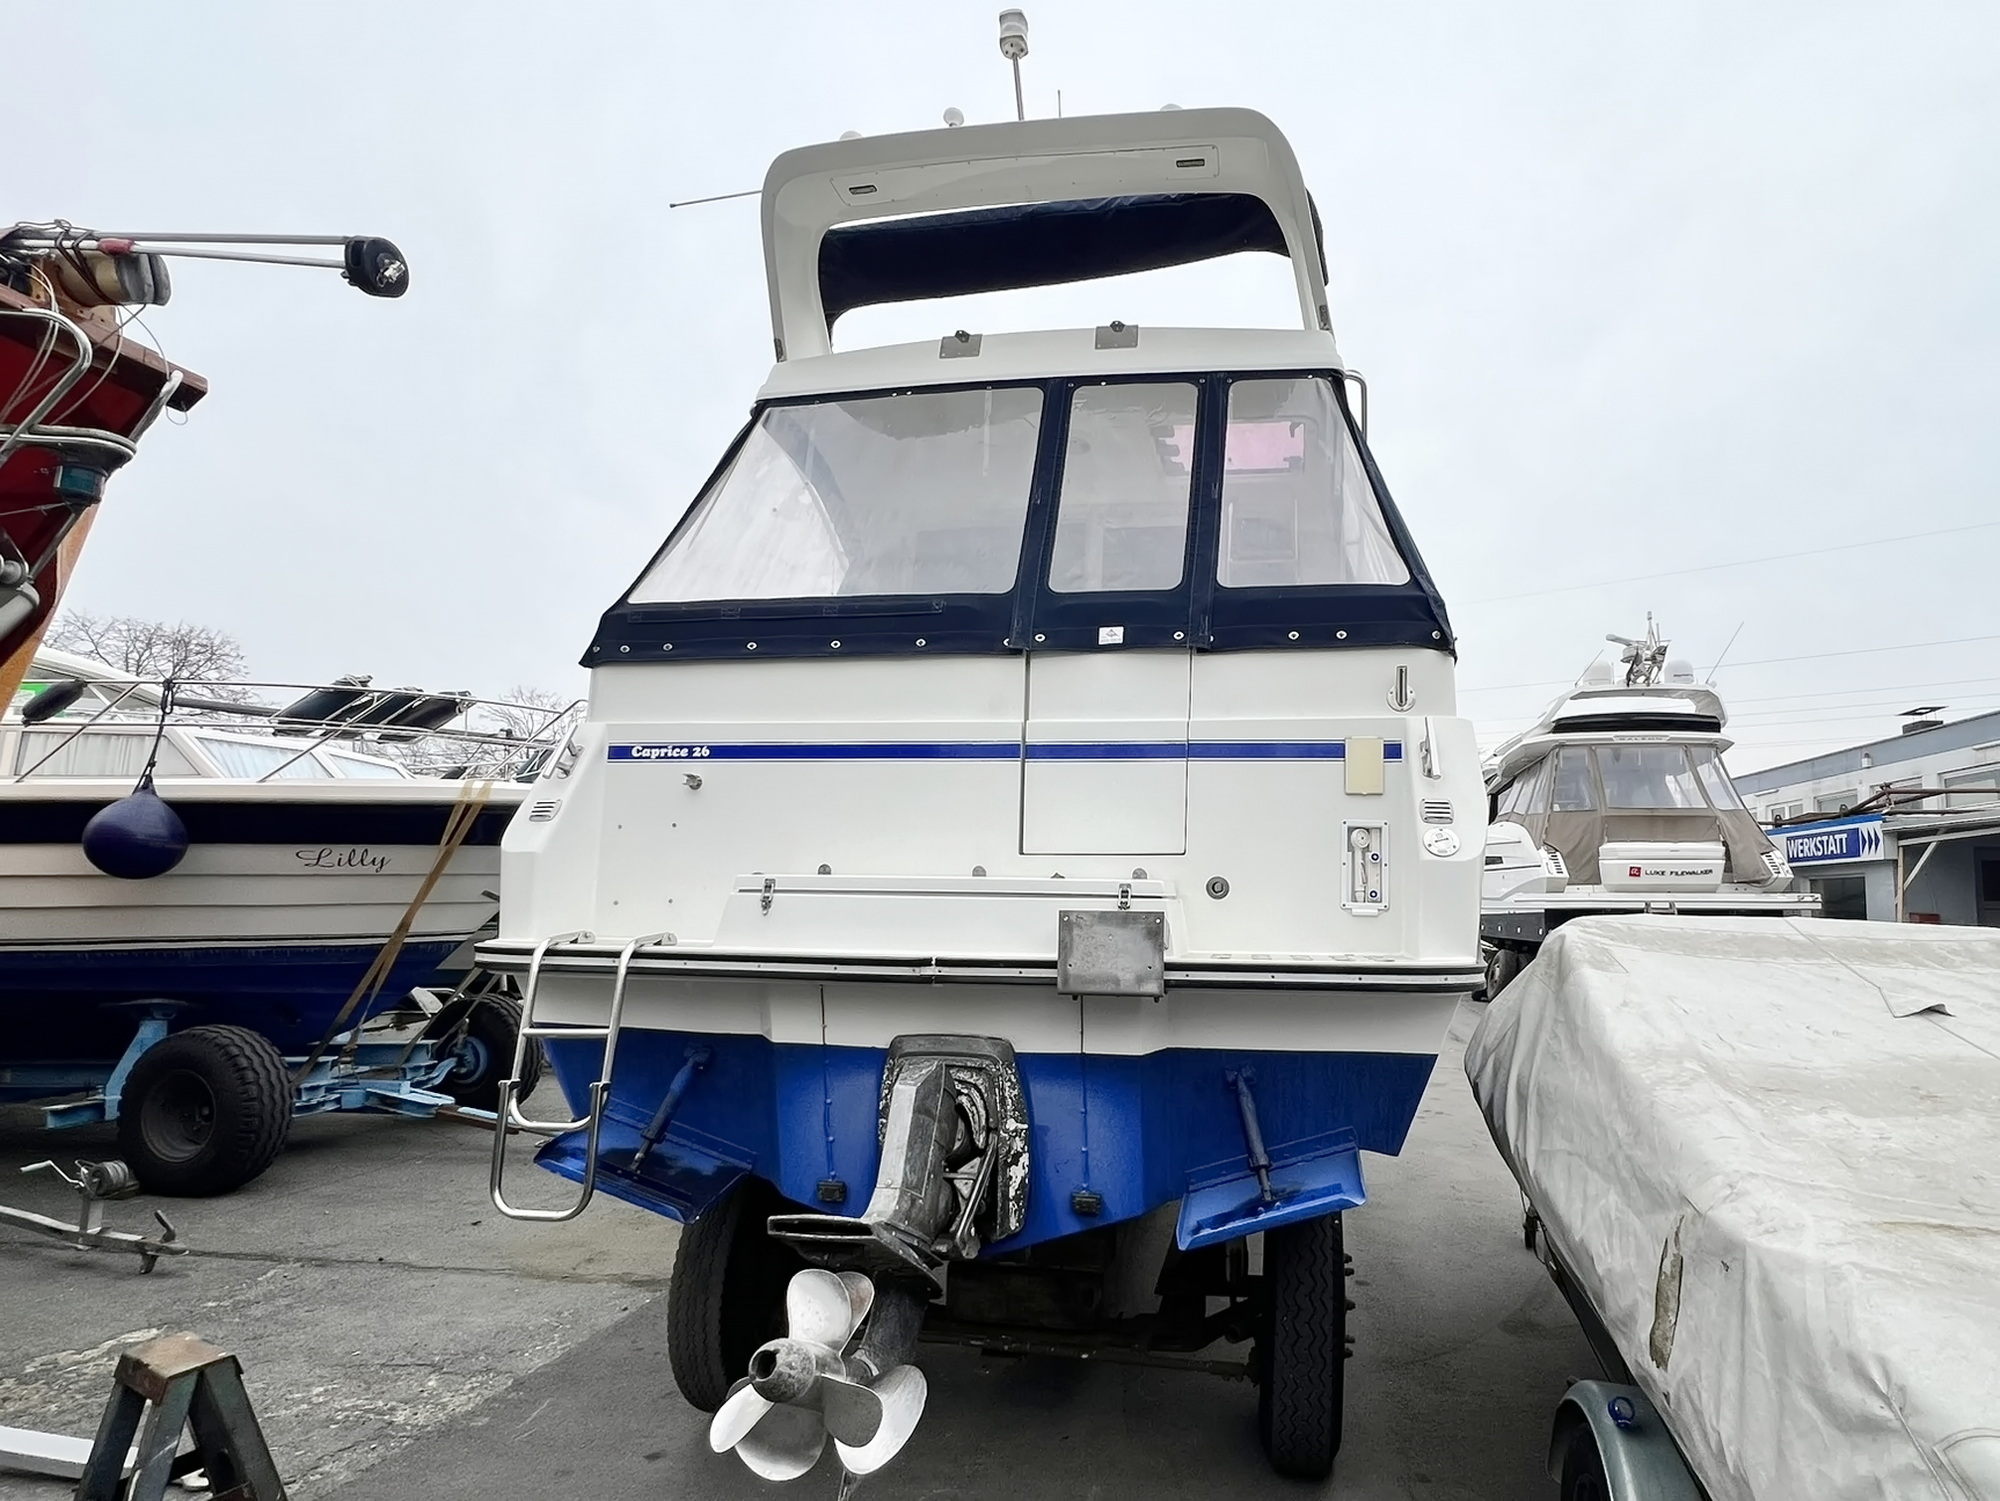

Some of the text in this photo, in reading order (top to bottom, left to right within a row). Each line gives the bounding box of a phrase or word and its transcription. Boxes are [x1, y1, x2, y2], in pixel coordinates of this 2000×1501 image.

[631, 745, 710, 760] Caprice 26
[1787, 833, 1848, 858] WERKSTATT
[295, 847, 392, 873] Lilly
